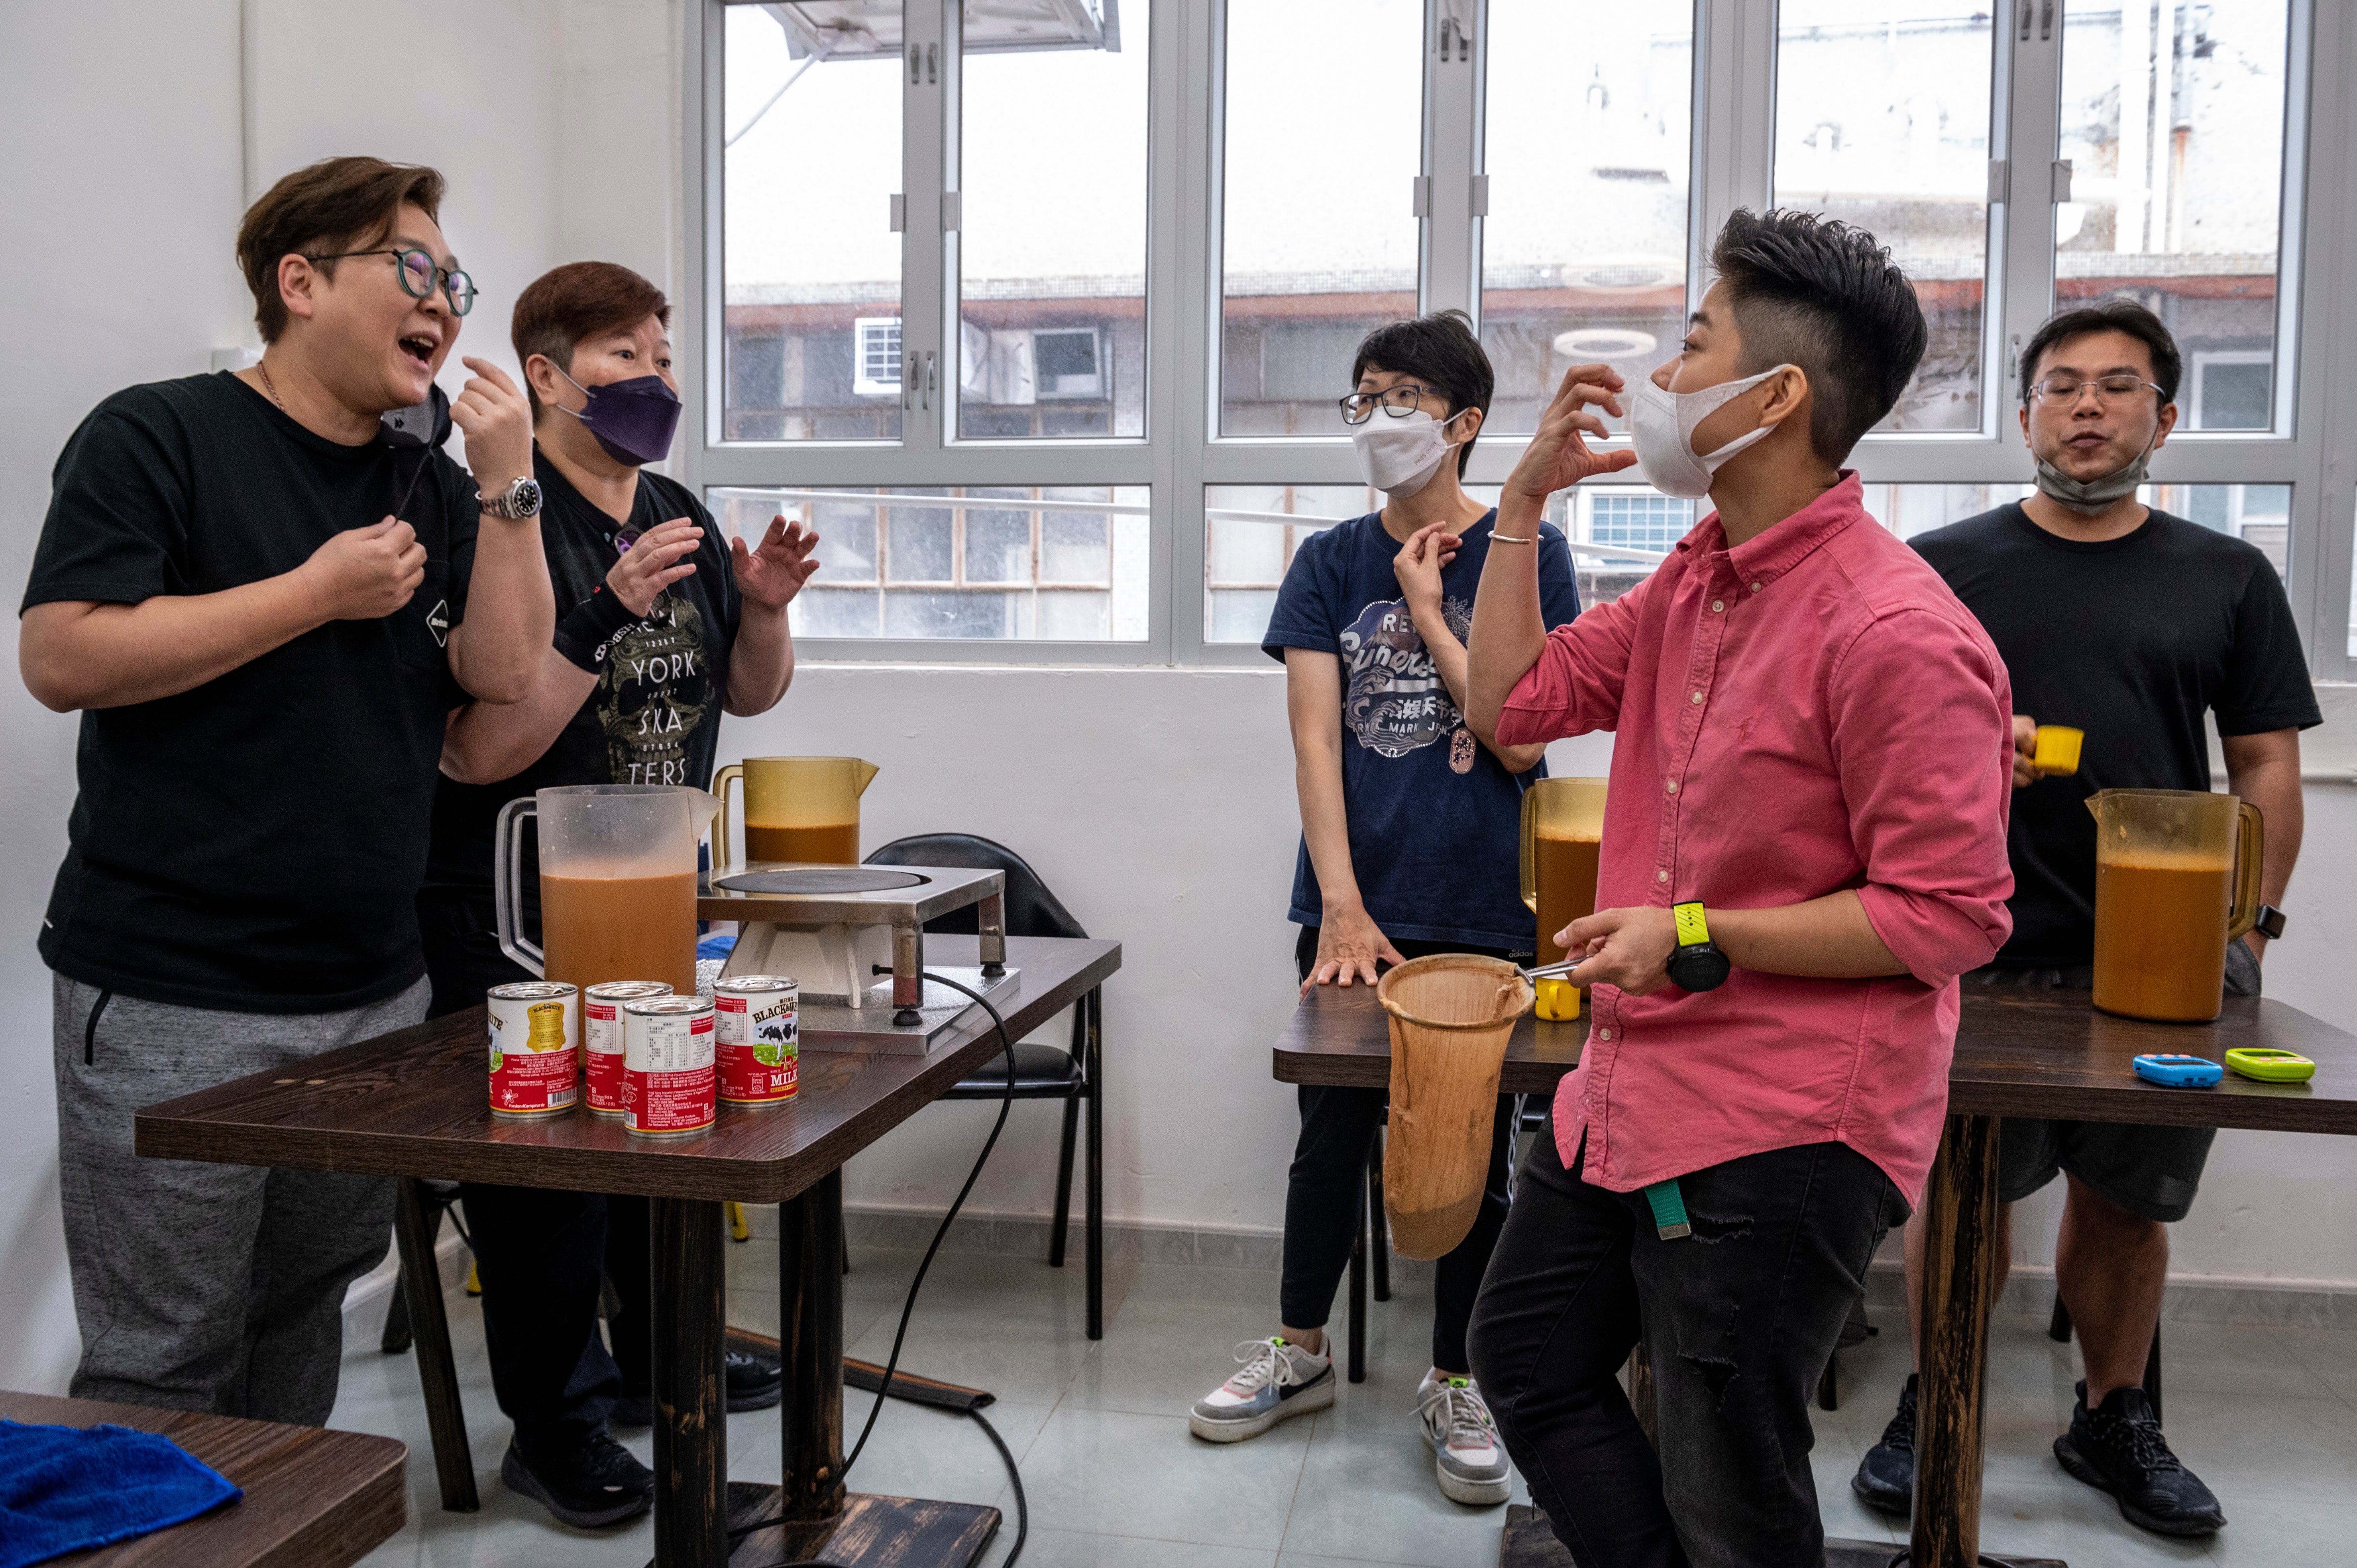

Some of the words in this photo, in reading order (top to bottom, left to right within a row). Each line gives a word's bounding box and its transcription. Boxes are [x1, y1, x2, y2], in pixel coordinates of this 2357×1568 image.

[604, 623, 636, 646] HSBC
[1383, 613, 1418, 633] RE
[631, 651, 696, 686] YORK
[638, 706, 683, 735] SKA
[643, 742, 678, 752] 87654
[628, 758, 685, 785] TERS
[770, 1068, 797, 1087] MILK
